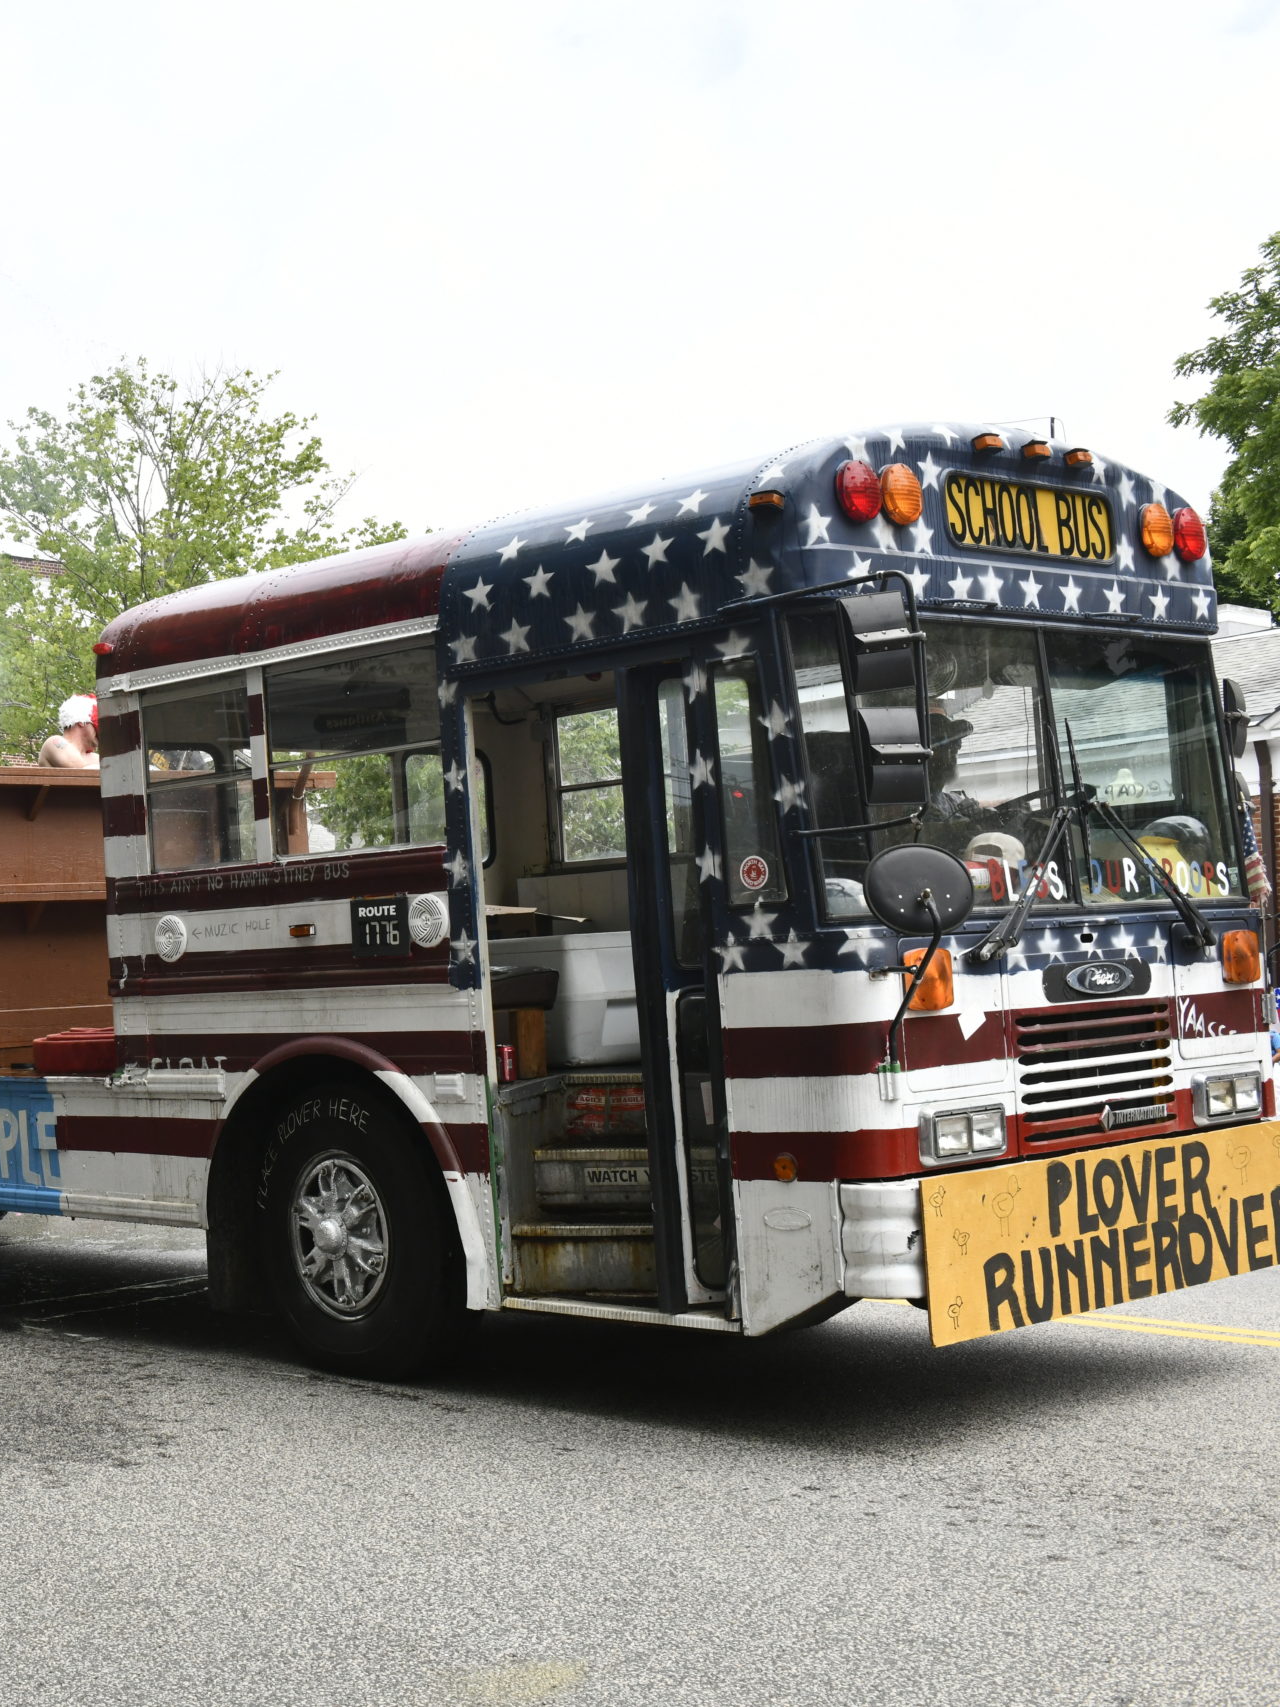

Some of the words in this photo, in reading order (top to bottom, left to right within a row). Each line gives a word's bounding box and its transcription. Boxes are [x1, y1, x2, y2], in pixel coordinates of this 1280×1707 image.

[947, 474, 1049, 553] SCHOOL
[1055, 492, 1106, 560] BUS
[136, 881, 165, 898] THIS
[207, 875, 224, 892] NO
[273, 865, 316, 883] JITNEY
[324, 862, 350, 881] BUS
[988, 858, 1065, 901] BLESS
[1090, 857, 1140, 894] OUR
[1142, 856, 1230, 897] TROOPS
[358, 904, 397, 917] ROUTE
[204, 922, 239, 938] MUZIC
[245, 918, 271, 932] HOLE
[365, 920, 400, 945] 1776
[276, 1098, 322, 1145] PLOVER
[328, 1097, 372, 1135] HERE
[1115, 1104, 1168, 1124] INTERNATIONAL
[587, 1170, 638, 1184] WATCH
[1046, 1140, 1216, 1238] PLOVER
